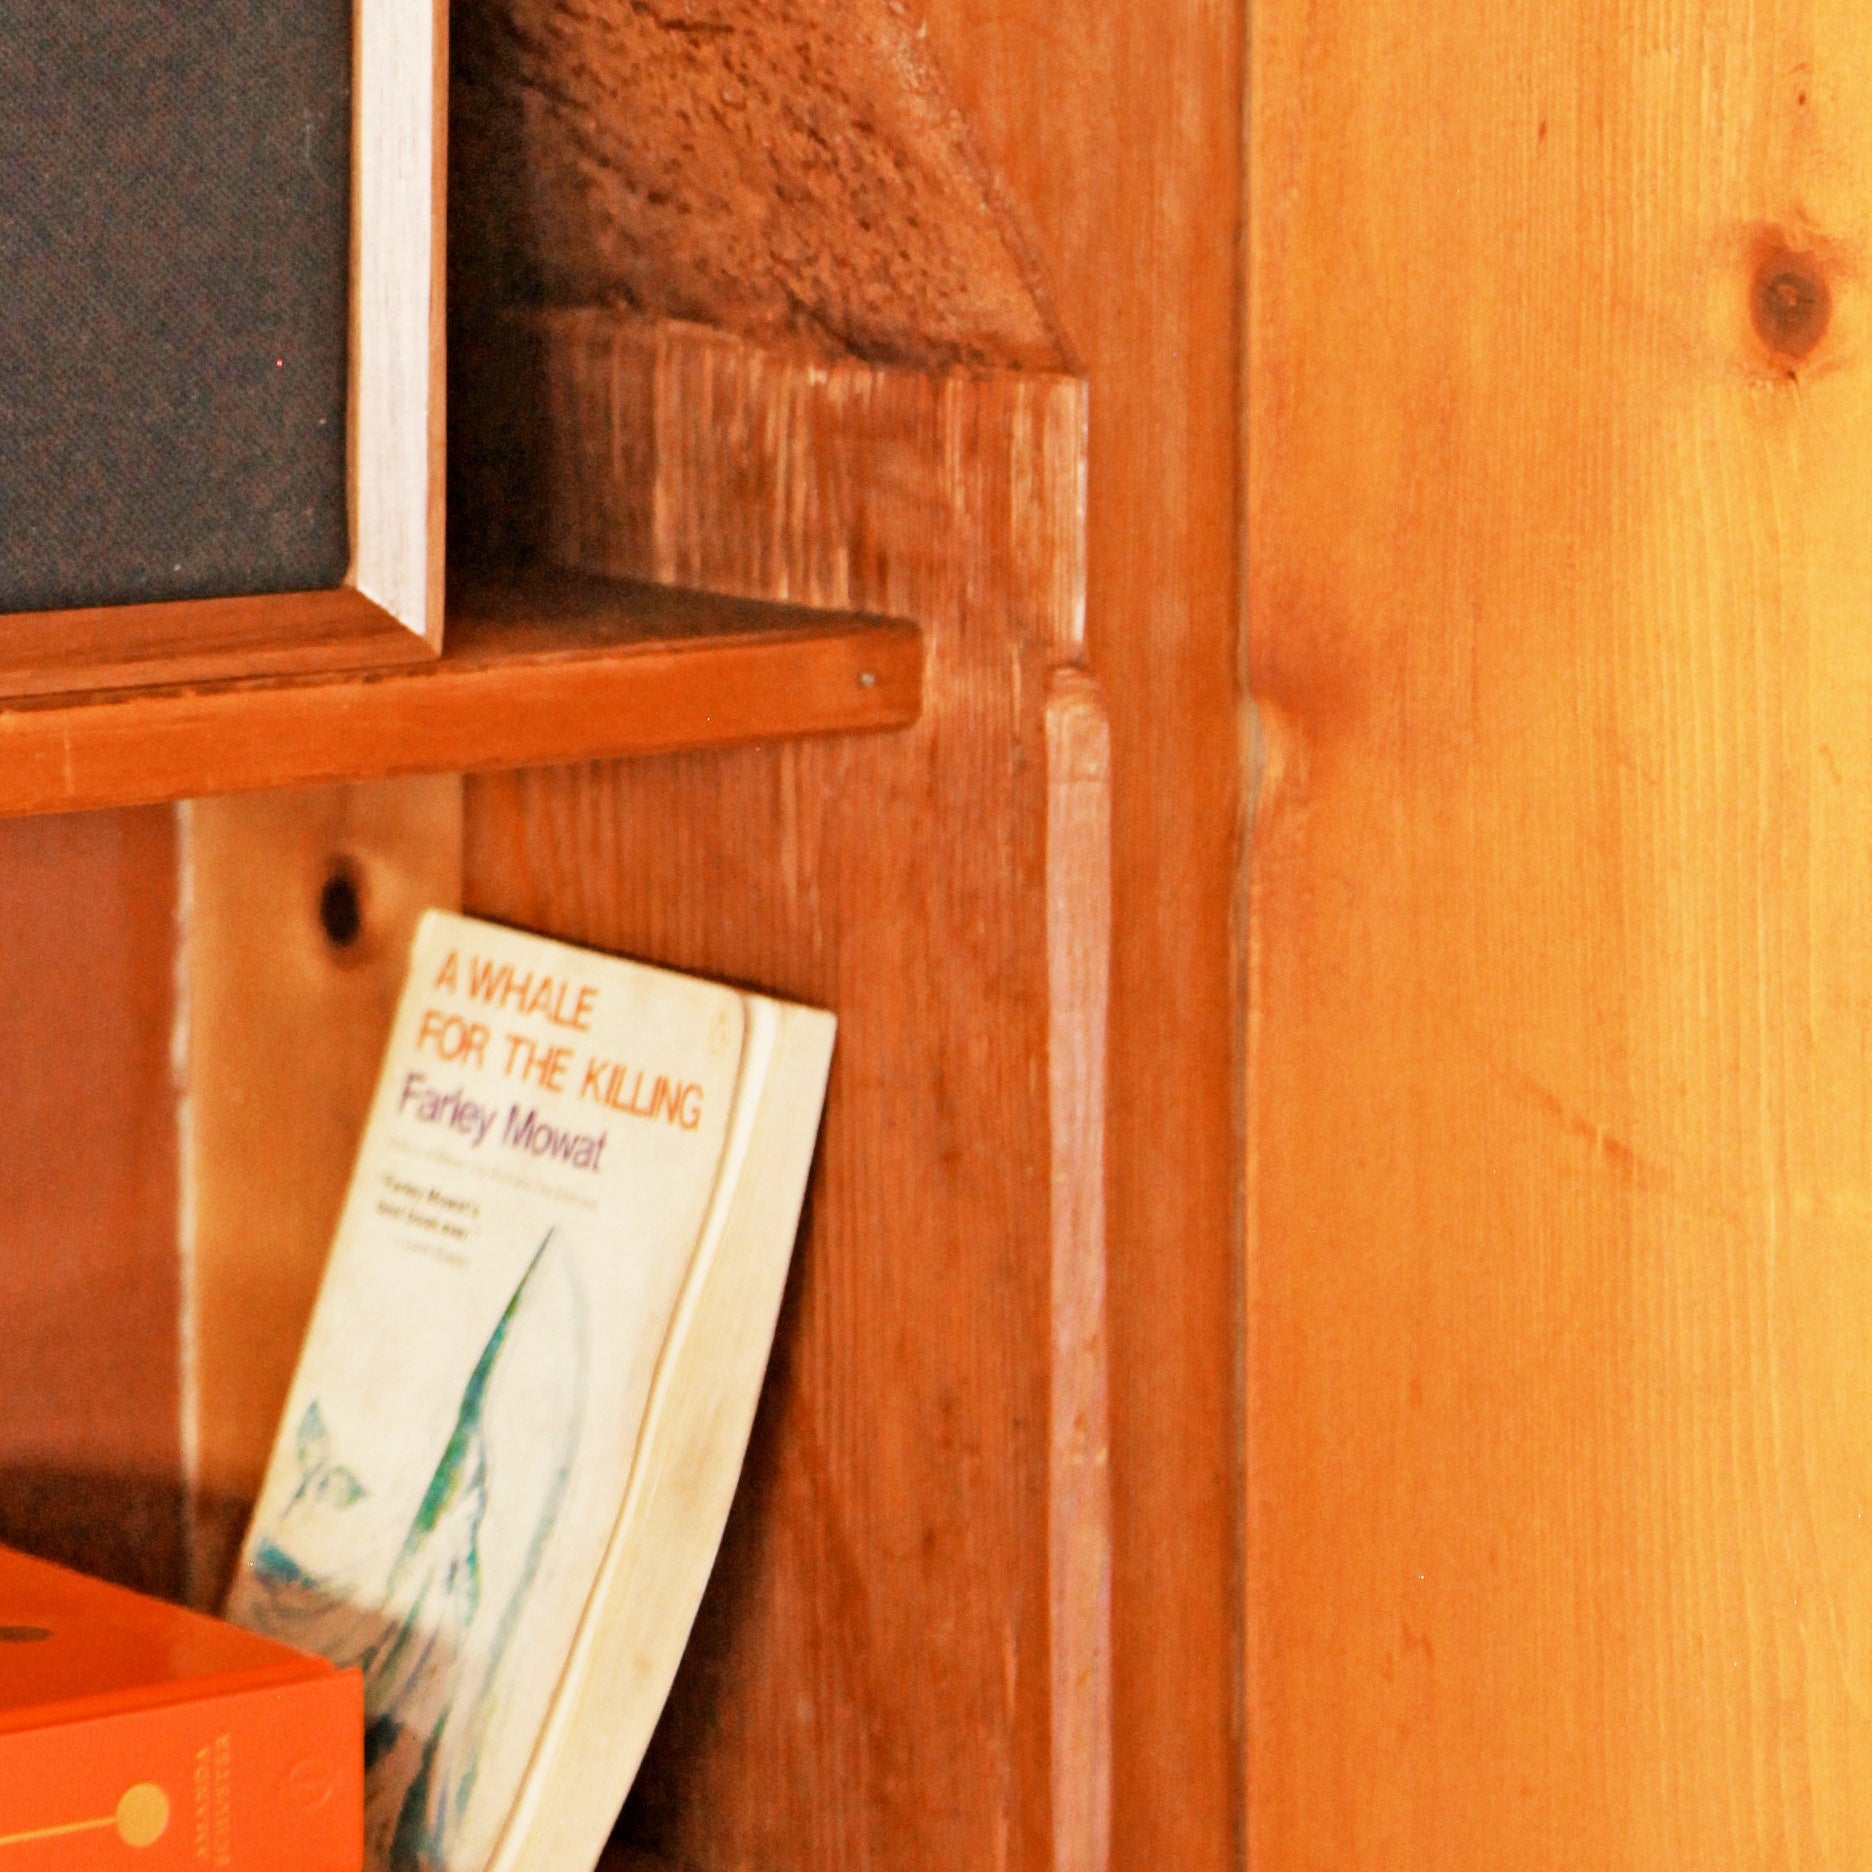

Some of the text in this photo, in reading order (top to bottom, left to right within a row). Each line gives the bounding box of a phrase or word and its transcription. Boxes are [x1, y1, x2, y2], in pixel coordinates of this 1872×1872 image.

[434, 952, 599, 1031] A WHALE
[418, 1010, 704, 1131] FOR THE KILLING
[398, 1074, 495, 1146] Farley
[503, 1103, 607, 1172] Mowat
